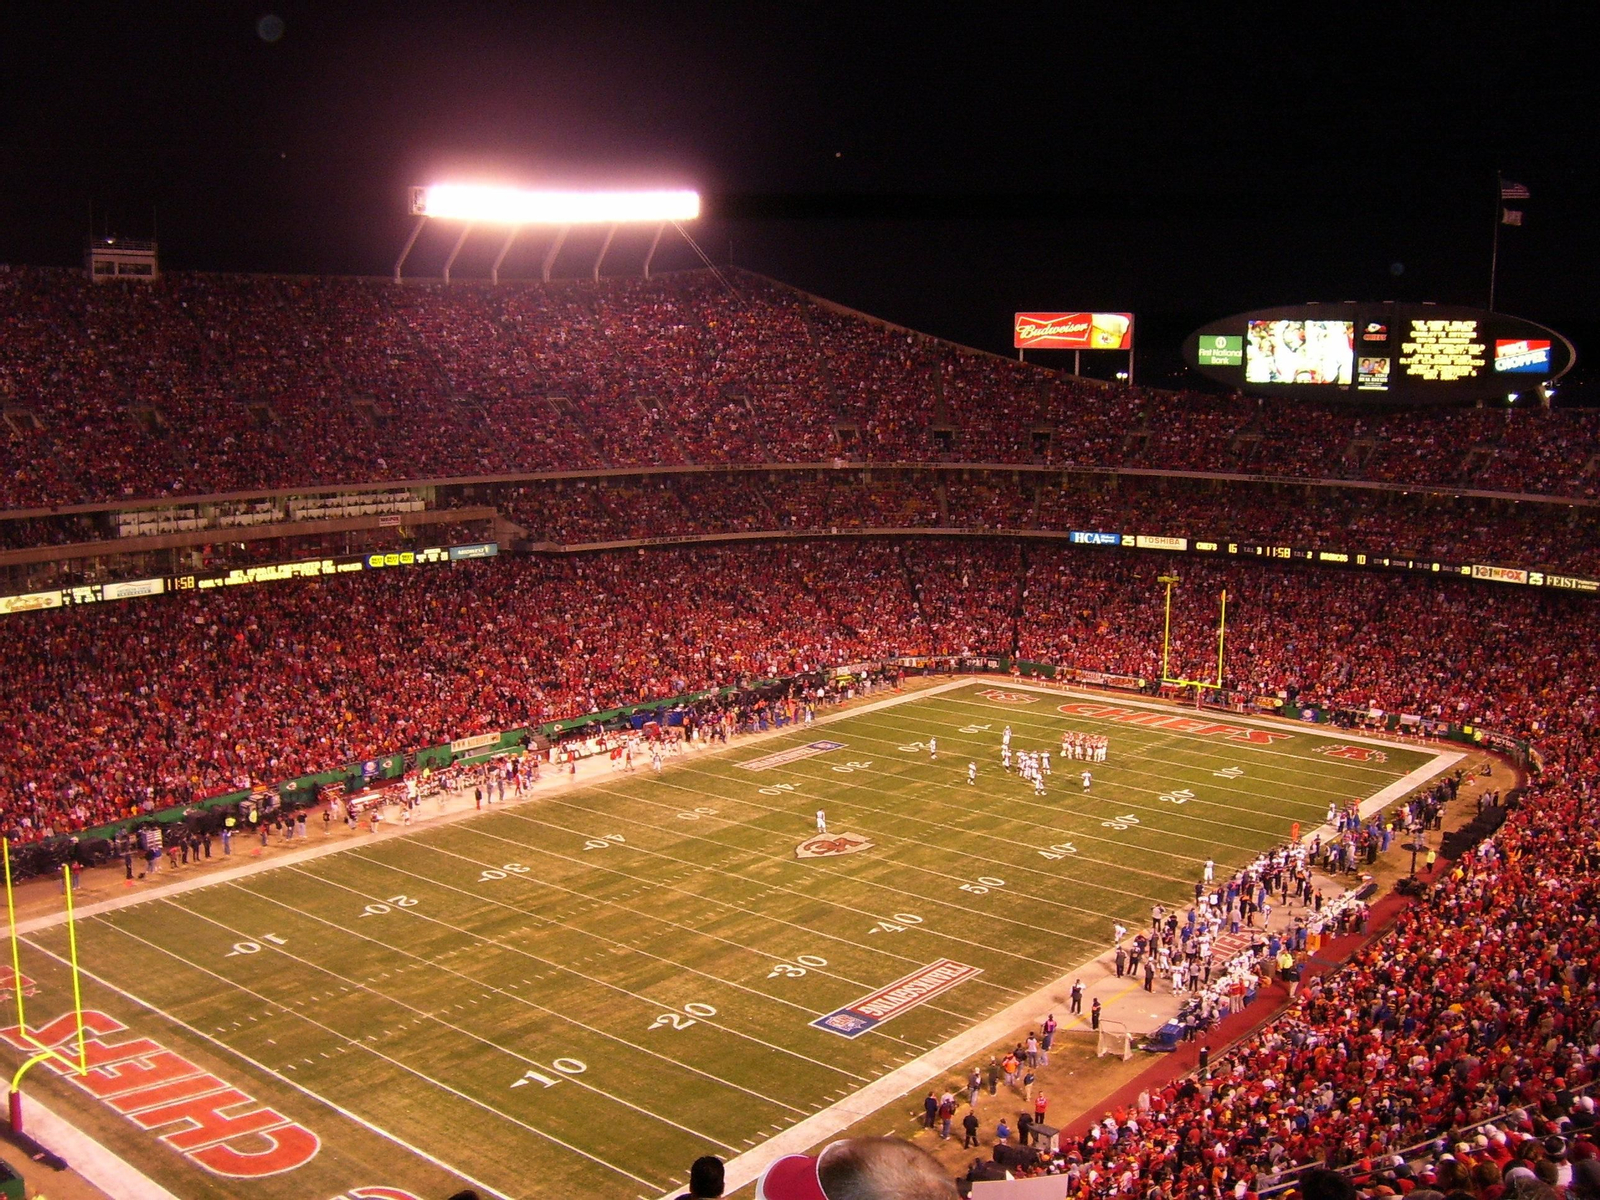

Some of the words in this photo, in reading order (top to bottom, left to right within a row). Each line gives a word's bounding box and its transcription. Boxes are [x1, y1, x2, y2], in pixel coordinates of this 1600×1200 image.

[1016, 322, 1088, 339] Budweiser
[1199, 349, 1212, 357] First
[1213, 349, 1242, 357] National
[1495, 351, 1548, 371] CHOPPER
[1074, 532, 1101, 544] HCA
[1143, 536, 1180, 545] TOSHIBA
[1196, 542, 1217, 551] CHIEFS
[1266, 546, 1291, 558] 11:58
[1306, 551, 1313, 559] 2
[1357, 554, 1366, 565] 10
[167, 576, 195, 591] 11:58
[1500, 569, 1523, 581] FOX
[1546, 575, 1579, 589] FEIST
[1057, 703, 1295, 745] CHIEFS
[1159, 790, 1195, 805] 20
[1101, 815, 1140, 831] 30
[585, 834, 625, 849] 40
[1038, 843, 1077, 860] 40
[482, 863, 530, 880] 30
[960, 876, 1005, 895] 50
[365, 895, 419, 914] 20
[878, 913, 923, 932] 40
[234, 933, 288, 954] 10
[774, 955, 828, 978] 30
[857, 963, 971, 1017] THANKSGIVING
[656, 1003, 716, 1030] 20
[524, 1058, 587, 1088] 10
[0, 1010, 321, 1178] CHIEFS
